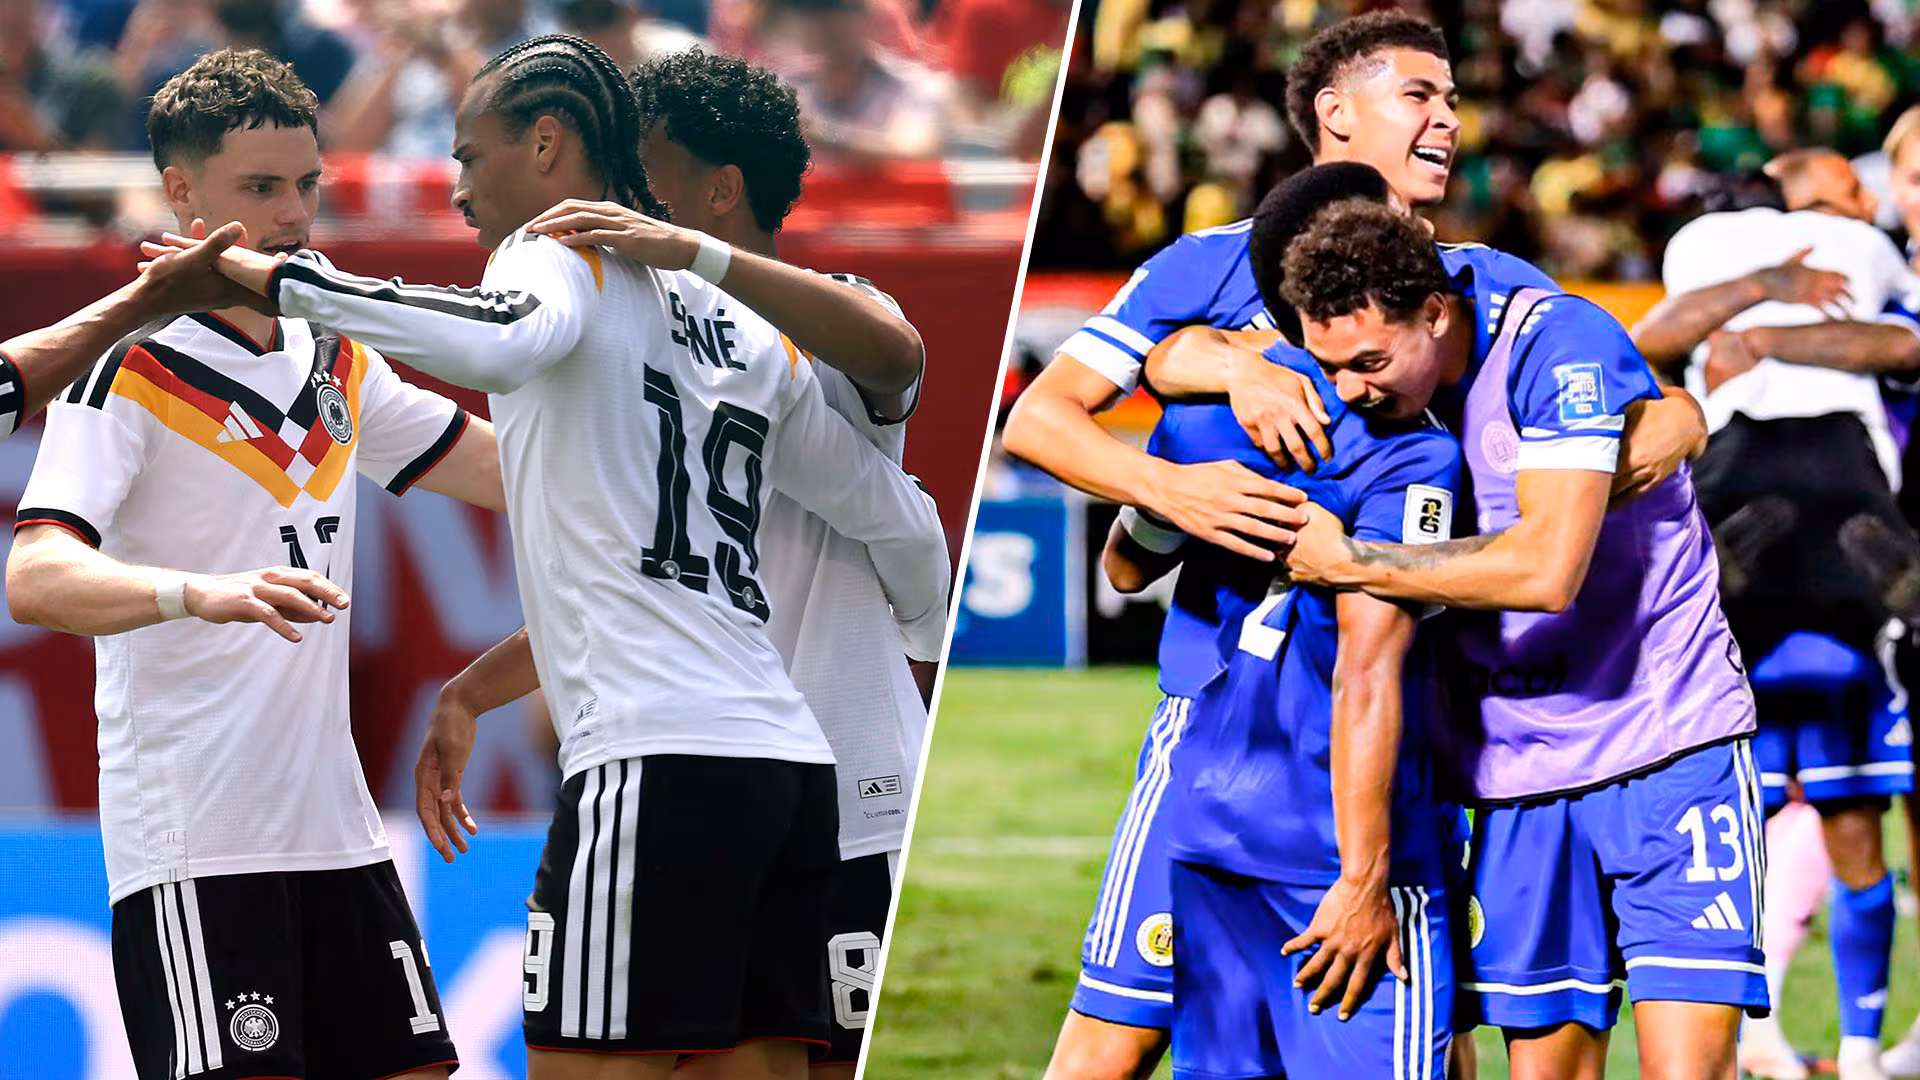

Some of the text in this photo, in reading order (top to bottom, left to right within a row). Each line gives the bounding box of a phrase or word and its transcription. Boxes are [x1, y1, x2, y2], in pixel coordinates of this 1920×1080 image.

[640, 362, 770, 624] 19
[1675, 804, 1744, 882] 13
[389, 939, 440, 1035] 1
[523, 911, 555, 1012] 9
[827, 930, 881, 1030] 8
